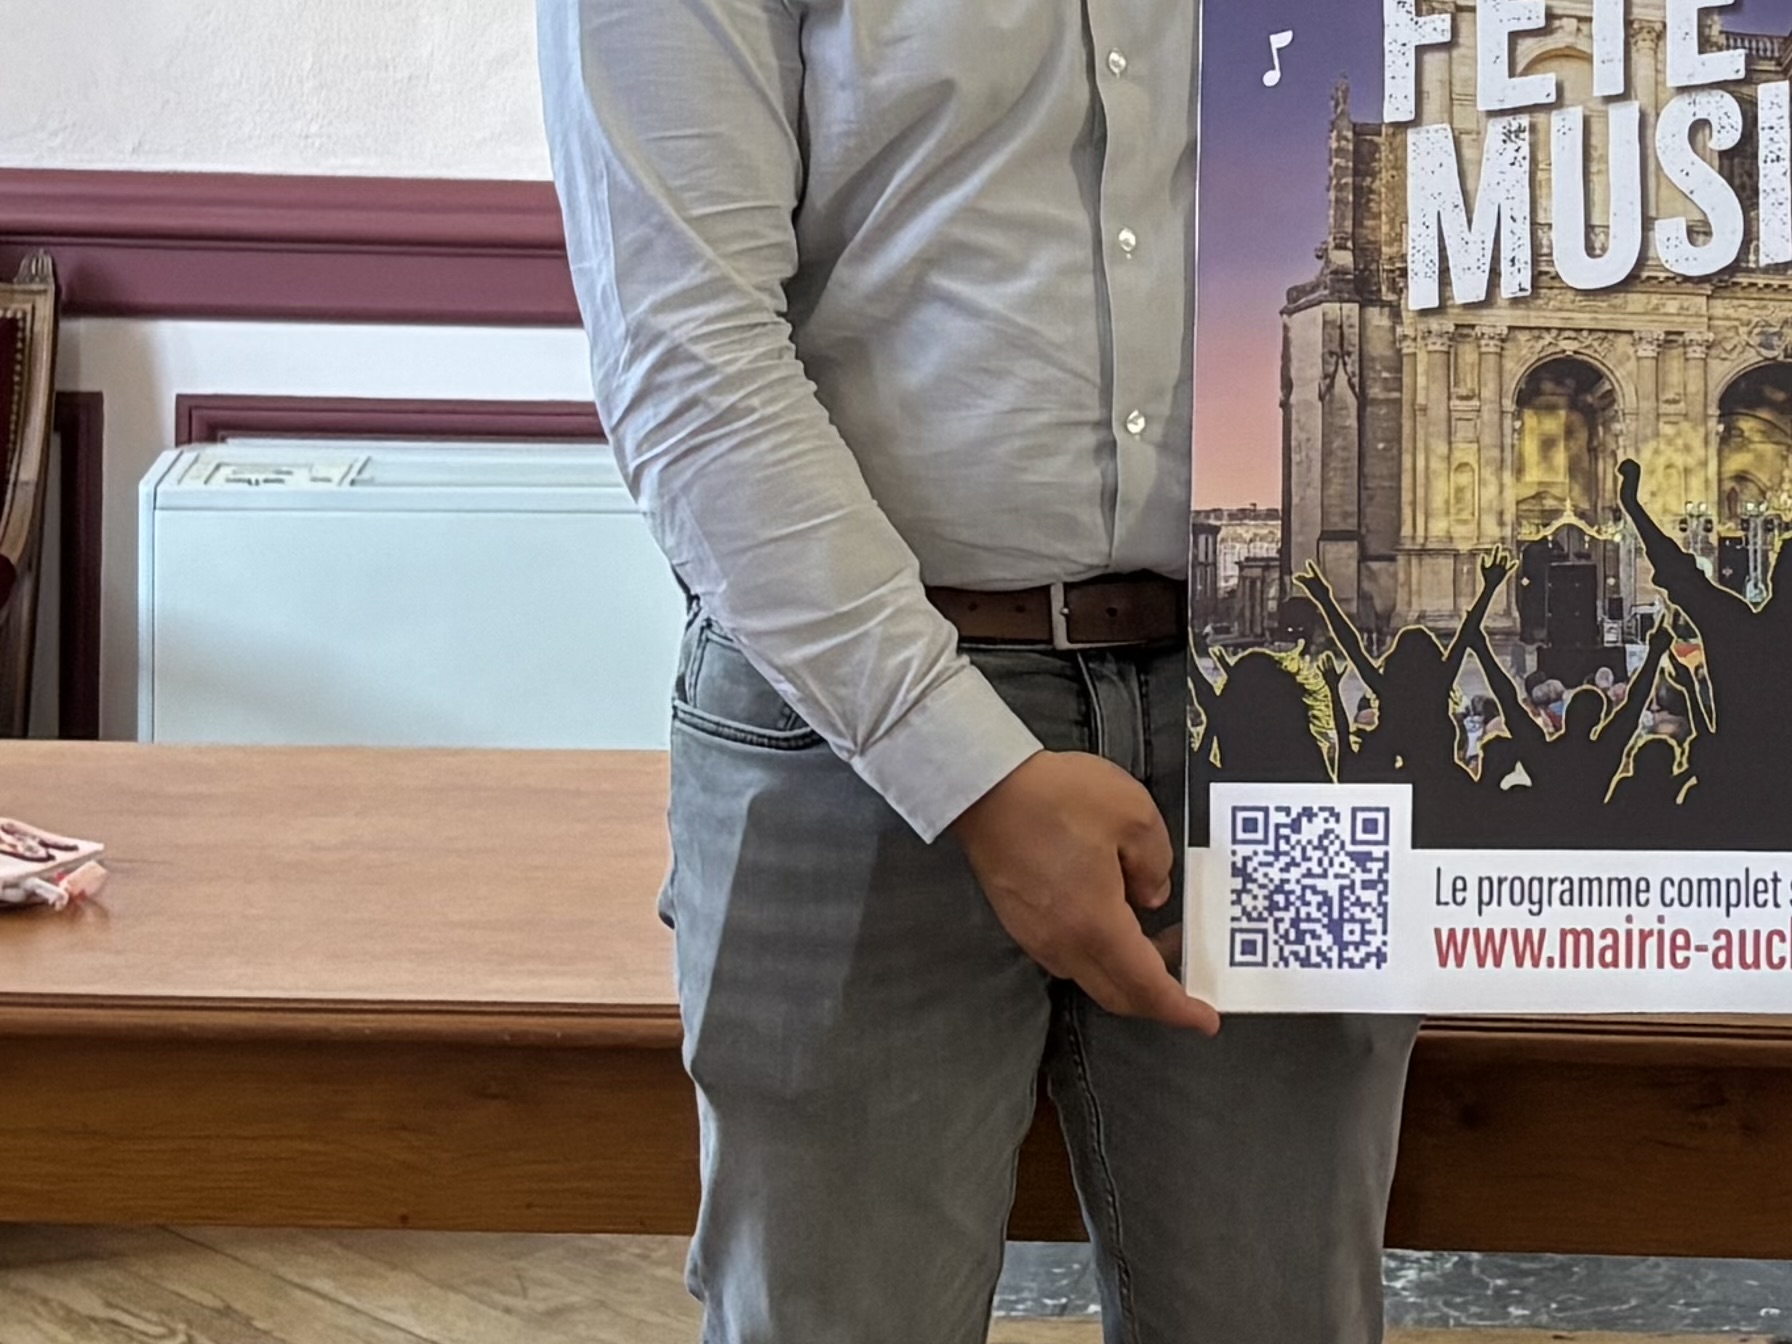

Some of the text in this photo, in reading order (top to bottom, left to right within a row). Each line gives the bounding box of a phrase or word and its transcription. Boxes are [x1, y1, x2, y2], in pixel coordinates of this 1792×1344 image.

[1435, 867, 1467, 906] Le
[1477, 874, 1650, 917] programme
[1660, 867, 1781, 918] complet
